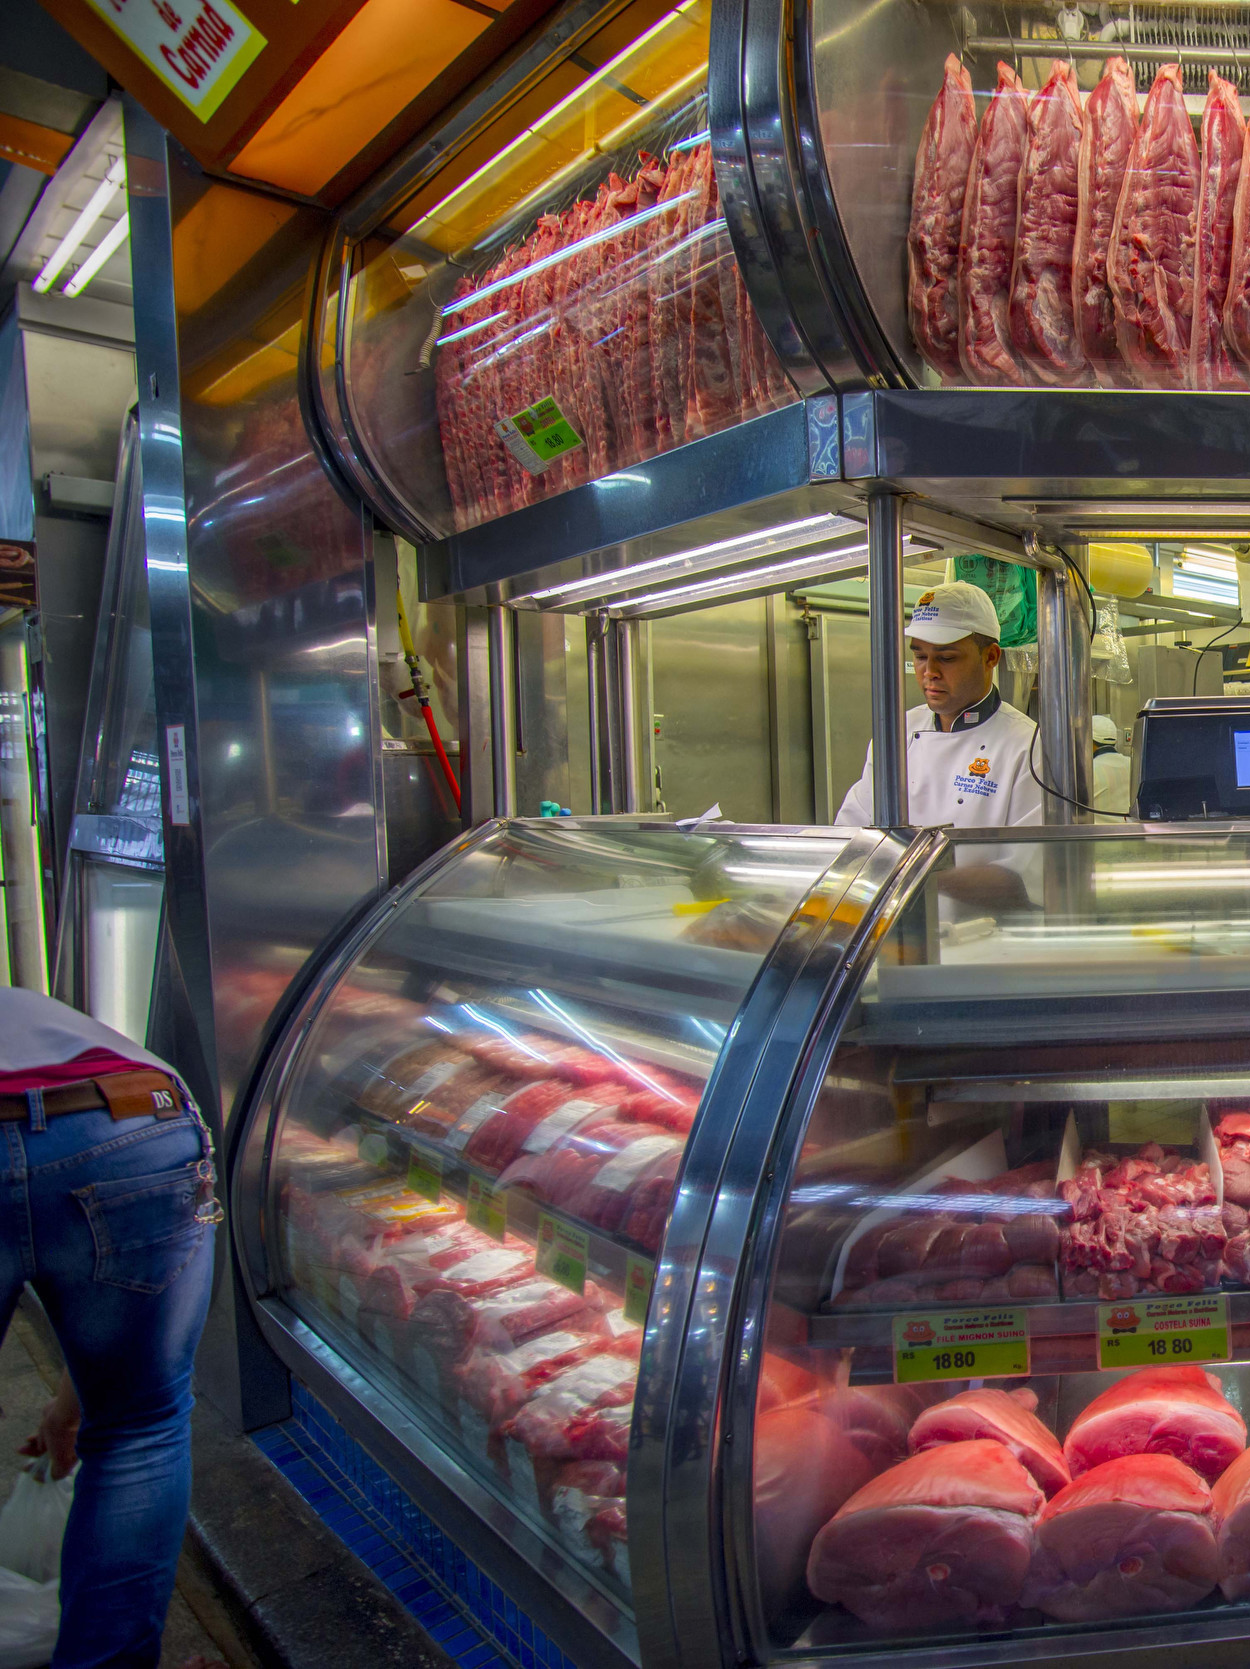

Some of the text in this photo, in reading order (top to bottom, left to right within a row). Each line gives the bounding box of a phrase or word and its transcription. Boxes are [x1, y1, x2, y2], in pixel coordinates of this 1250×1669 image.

[953, 781, 973, 789] Carnes
[955, 775, 998, 788] Porco Feliz
[151, 1090, 174, 1109] DS
[944, 1316, 979, 1324] Porco
[1154, 1320, 1187, 1331] COSTELA
[958, 1332, 995, 1342] MIGNON
